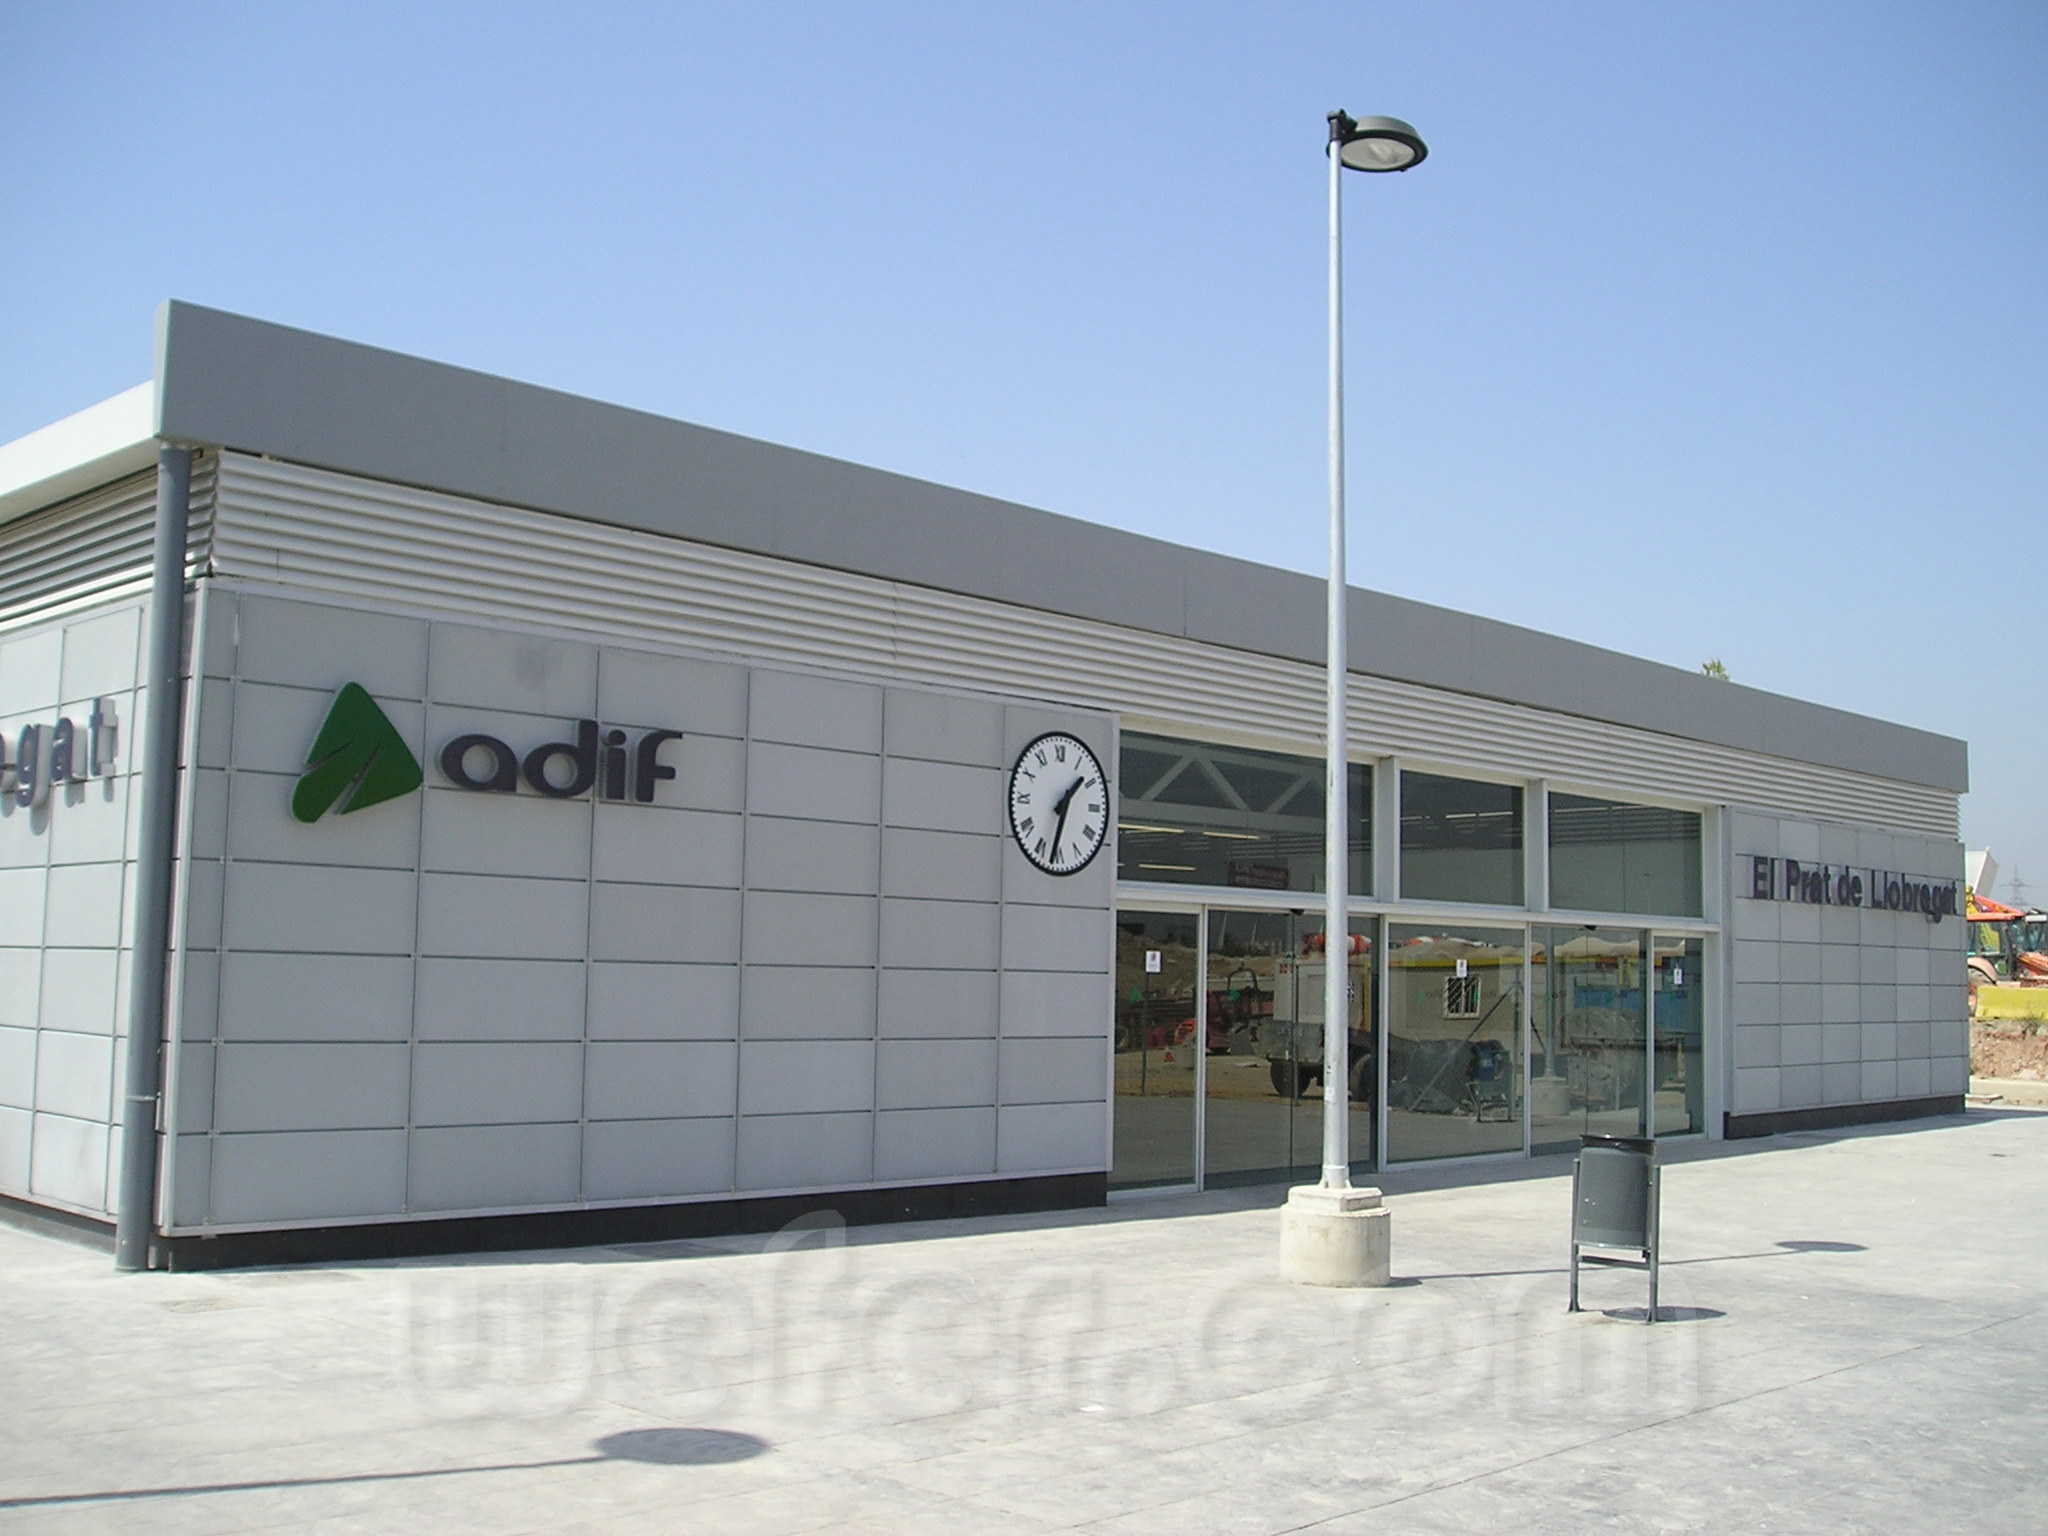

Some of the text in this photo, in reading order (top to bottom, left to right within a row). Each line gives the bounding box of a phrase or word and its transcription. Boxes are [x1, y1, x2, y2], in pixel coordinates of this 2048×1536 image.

[0, 698, 106, 808] gat
[440, 719, 683, 803] adif
[1753, 855, 1958, 924] El Prat de Llobregat
